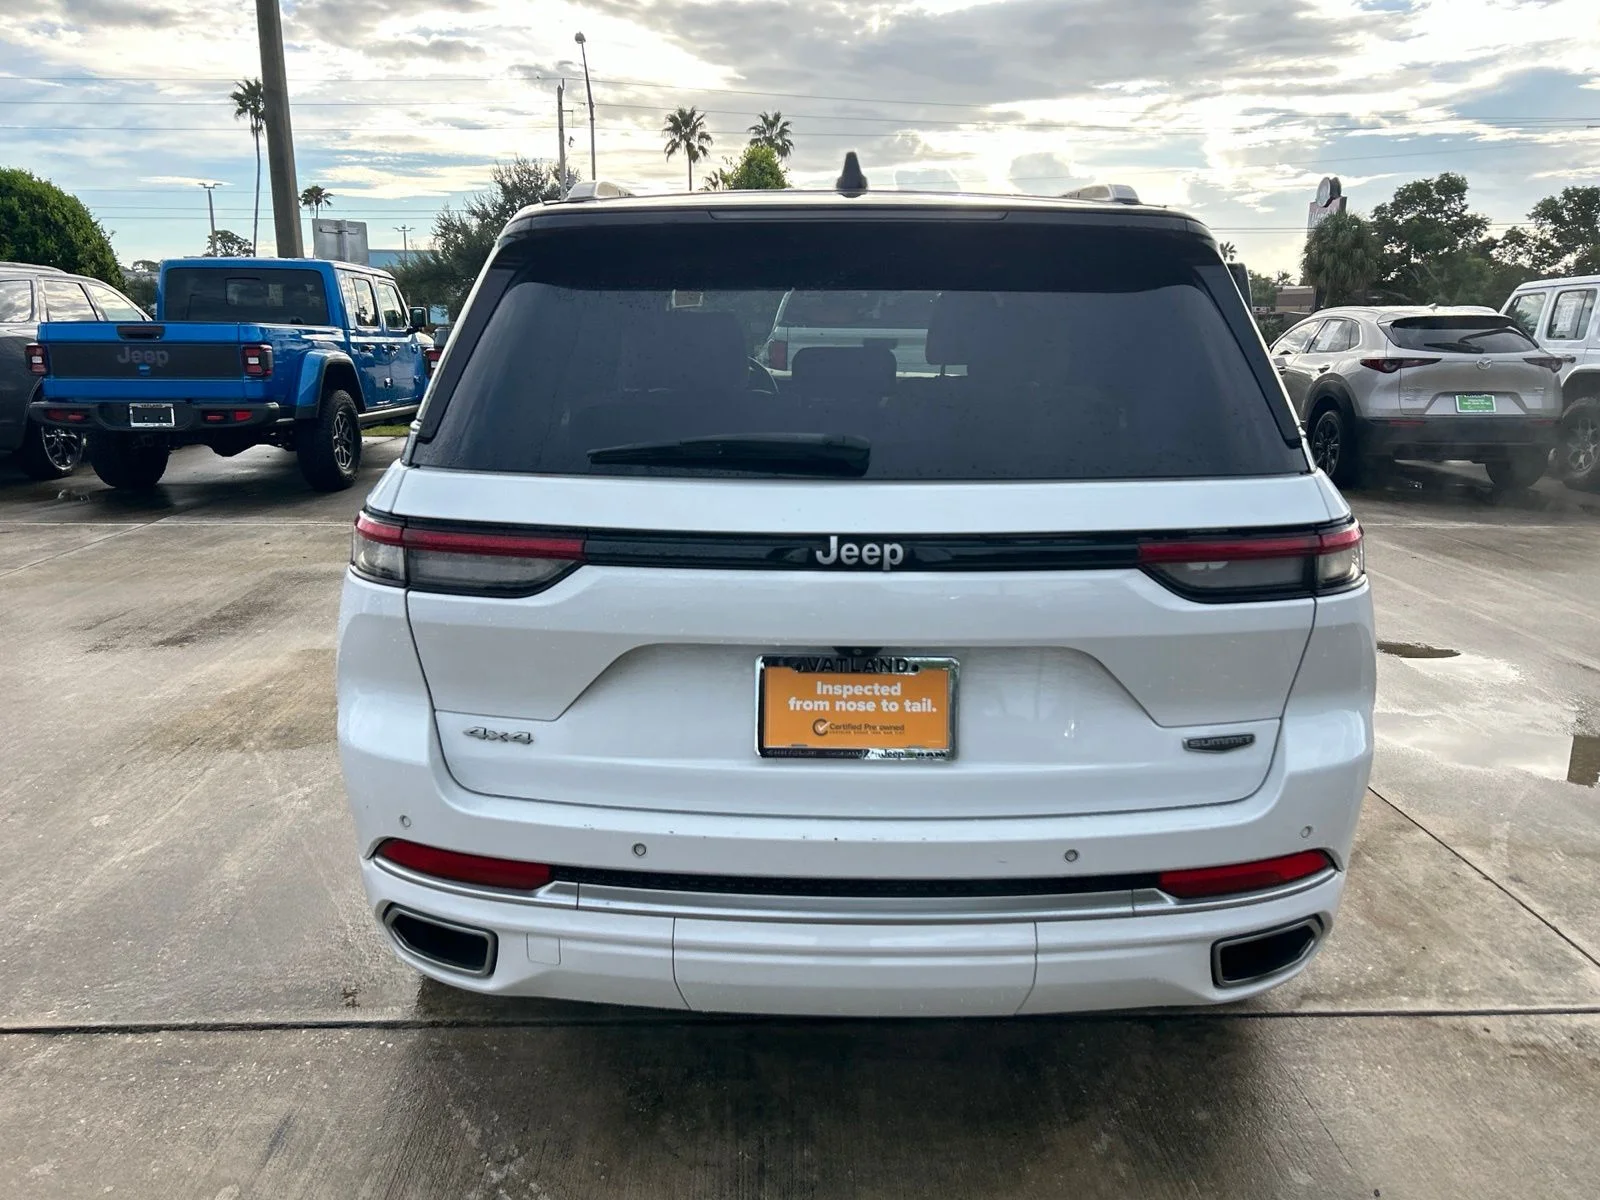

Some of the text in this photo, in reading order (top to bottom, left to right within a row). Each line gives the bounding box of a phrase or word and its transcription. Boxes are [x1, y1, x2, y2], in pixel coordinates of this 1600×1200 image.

[117, 346, 169, 368] Jeep
[816, 535, 904, 571] Jeep
[808, 657, 909, 673] VATLAND
[816, 681, 902, 699] Inspected
[788, 697, 937, 712] from nose to tail.
[463, 726, 534, 744] 4x4
[829, 723, 862, 731] Certified
